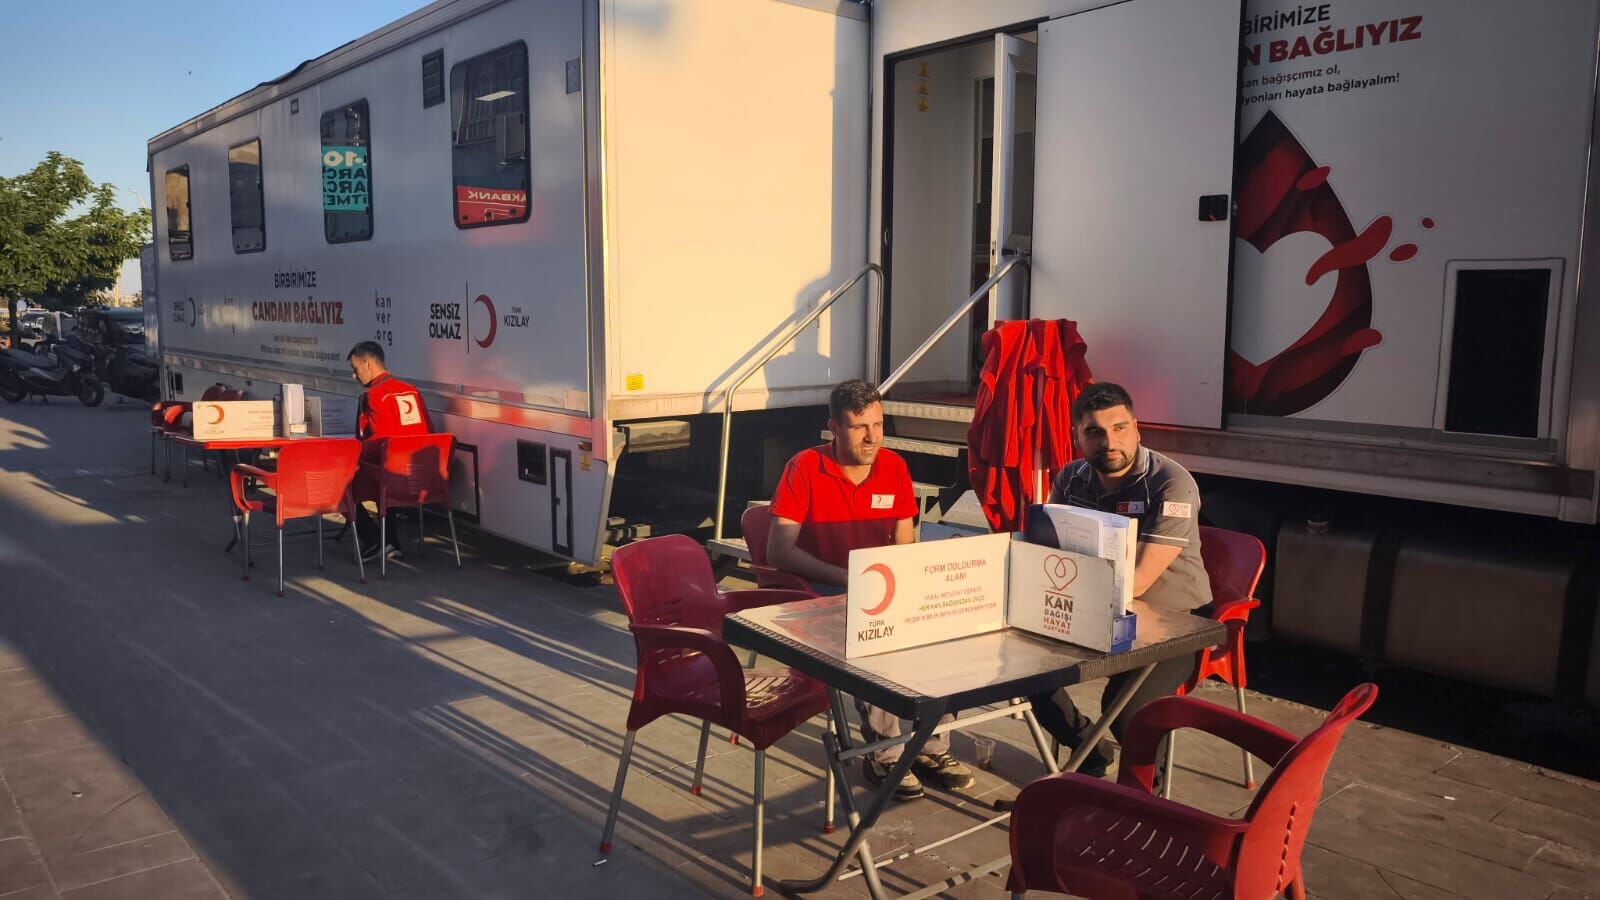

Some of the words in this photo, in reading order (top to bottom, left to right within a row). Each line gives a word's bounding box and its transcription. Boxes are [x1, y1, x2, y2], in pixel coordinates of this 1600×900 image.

[1243, 4, 1331, 36] BİRİMİZE
[1269, 15, 1423, 63] BAĞLIYIZ
[1262, 68, 1323, 86] bağışçımız
[1326, 64, 1341, 76] ol,
[1285, 84, 1325, 99] hayata
[1327, 73, 1400, 93] bağlayalım!
[375, 290, 391, 308] kan
[252, 301, 292, 321] CANDAN
[294, 296, 344, 325] BAĞLIYIZ
[376, 313, 391, 323] ver
[430, 303, 460, 321] SENSİZ
[504, 315, 530, 327] KIZILAY
[429, 323, 461, 340] OLMAZ
[924, 564, 946, 574] FORM
[947, 559, 986, 572] DOLDURMA
[945, 572, 967, 582] ALANI
[1044, 594, 1073, 613] KAN
[1043, 616, 1071, 629] HAYAT
[1044, 608, 1072, 622] BAĞIŞI
[869, 620, 885, 628] TÜRK
[858, 625, 894, 642] KIZILAY
